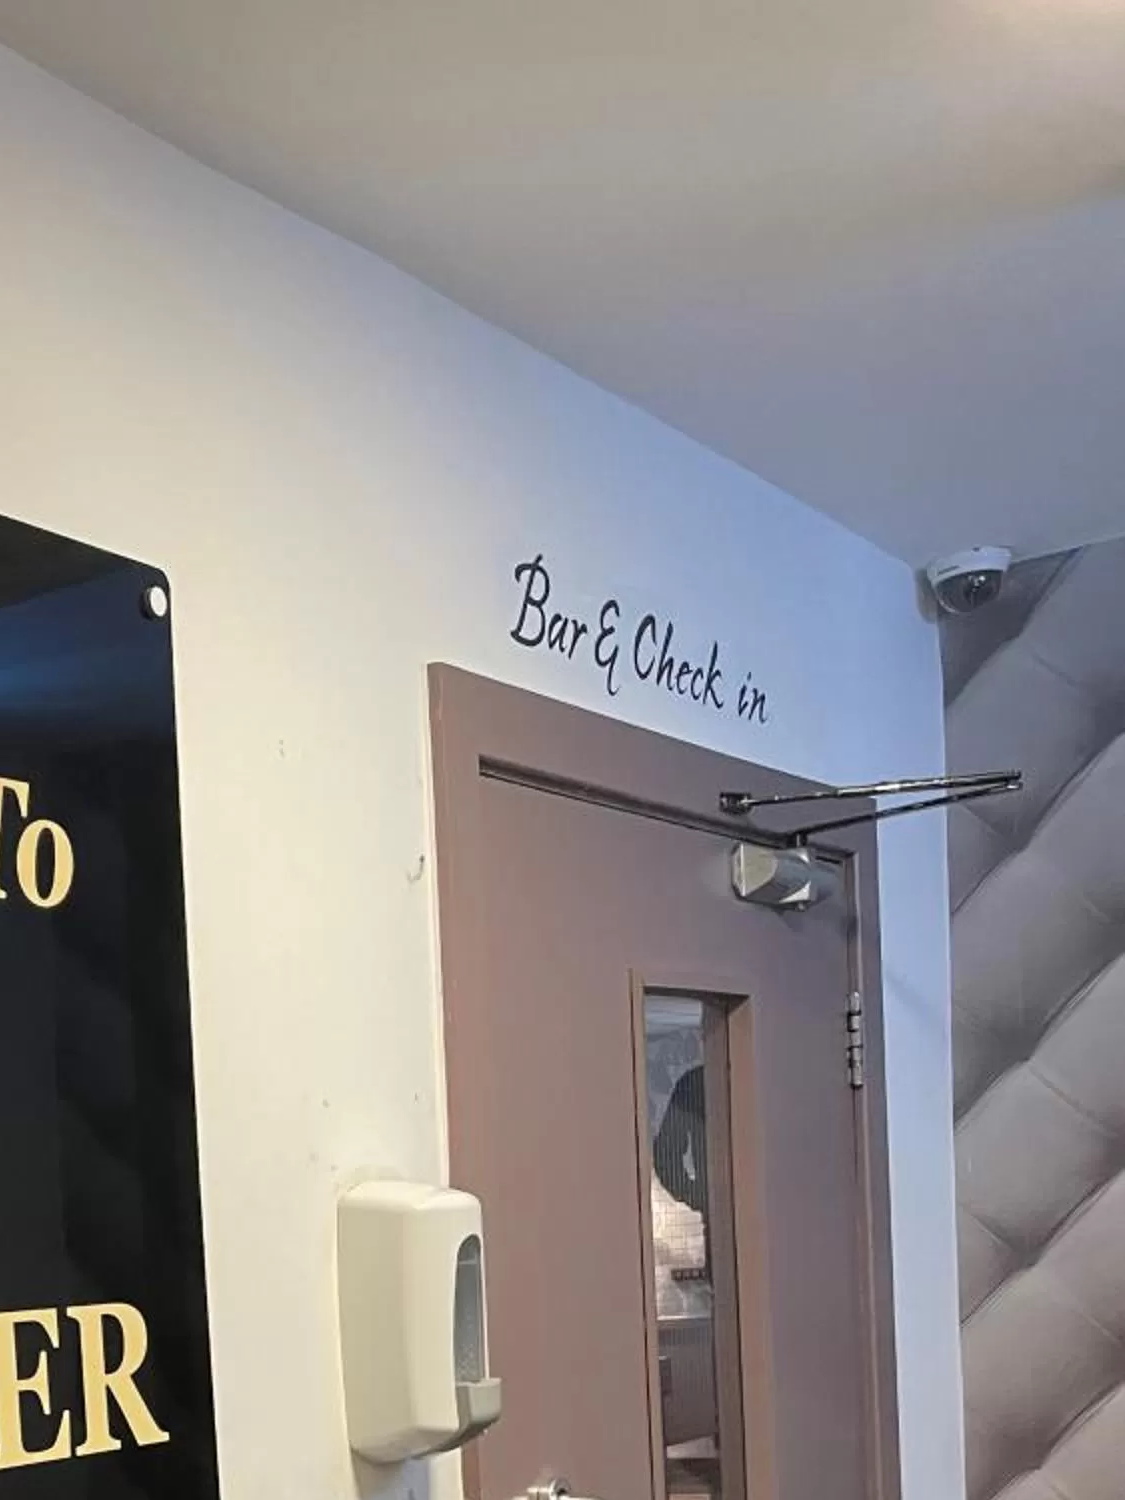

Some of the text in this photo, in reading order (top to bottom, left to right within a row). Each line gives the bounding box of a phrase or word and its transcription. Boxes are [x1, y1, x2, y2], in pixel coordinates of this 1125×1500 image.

[510, 554, 767, 724] Bar & Check in
